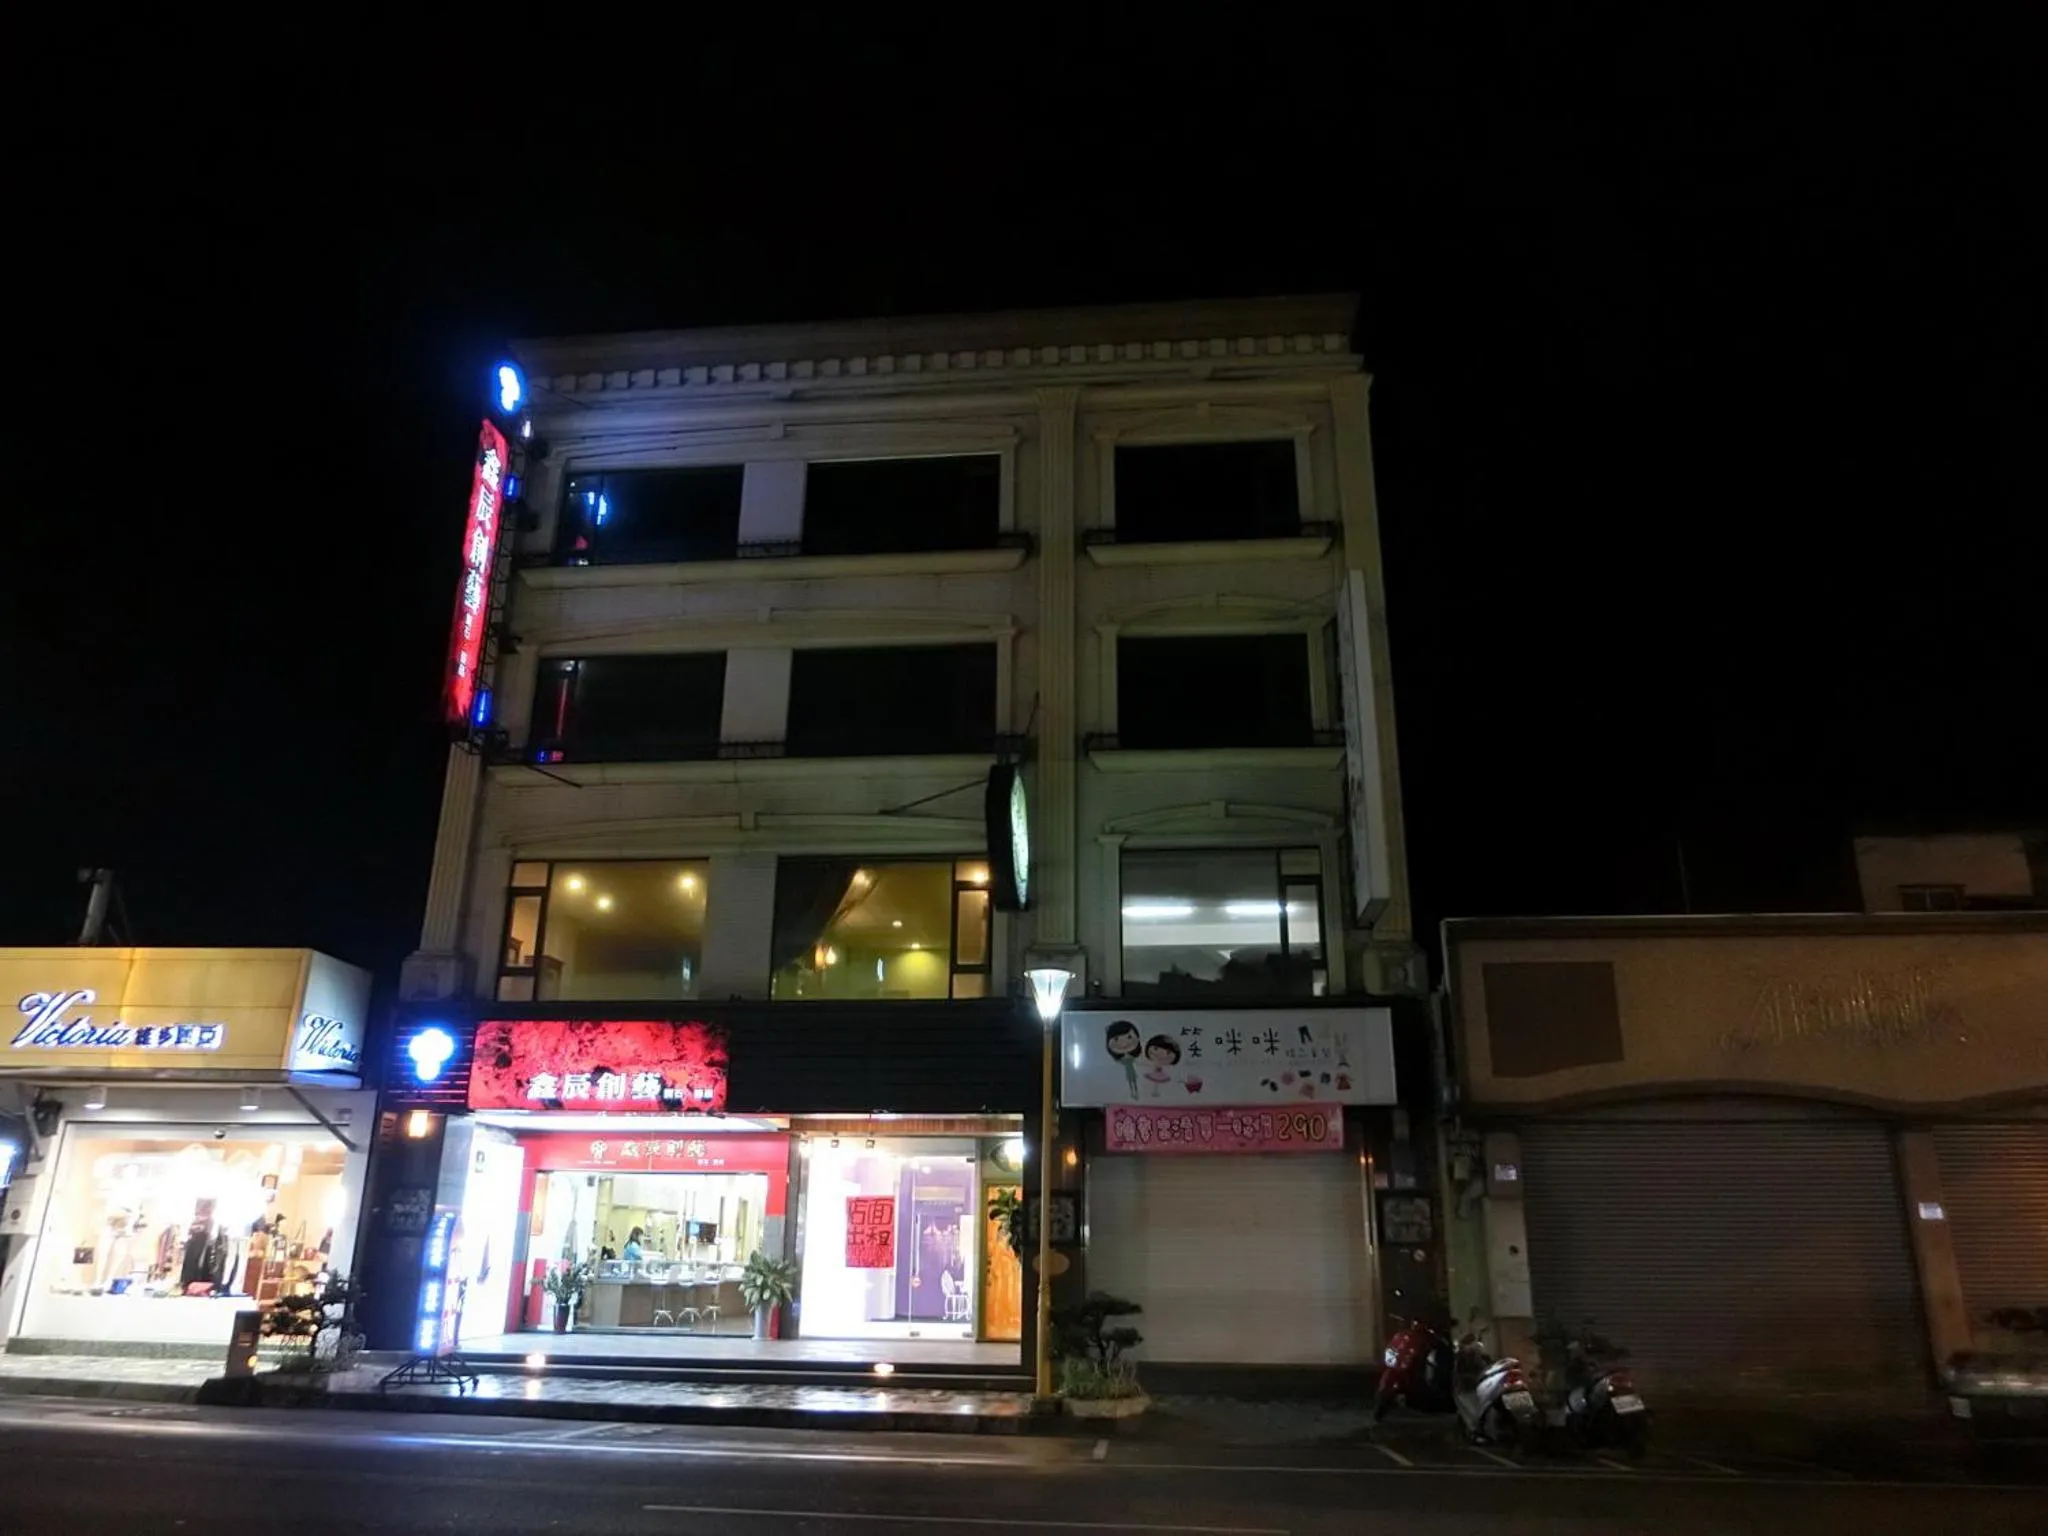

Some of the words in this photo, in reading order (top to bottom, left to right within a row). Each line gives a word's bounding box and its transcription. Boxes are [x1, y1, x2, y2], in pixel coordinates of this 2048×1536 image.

[10, 991, 134, 1047] Victoria
[1180, 1025, 1281, 1057] 笑咪咪
[1276, 1112, 1329, 1142] 290
